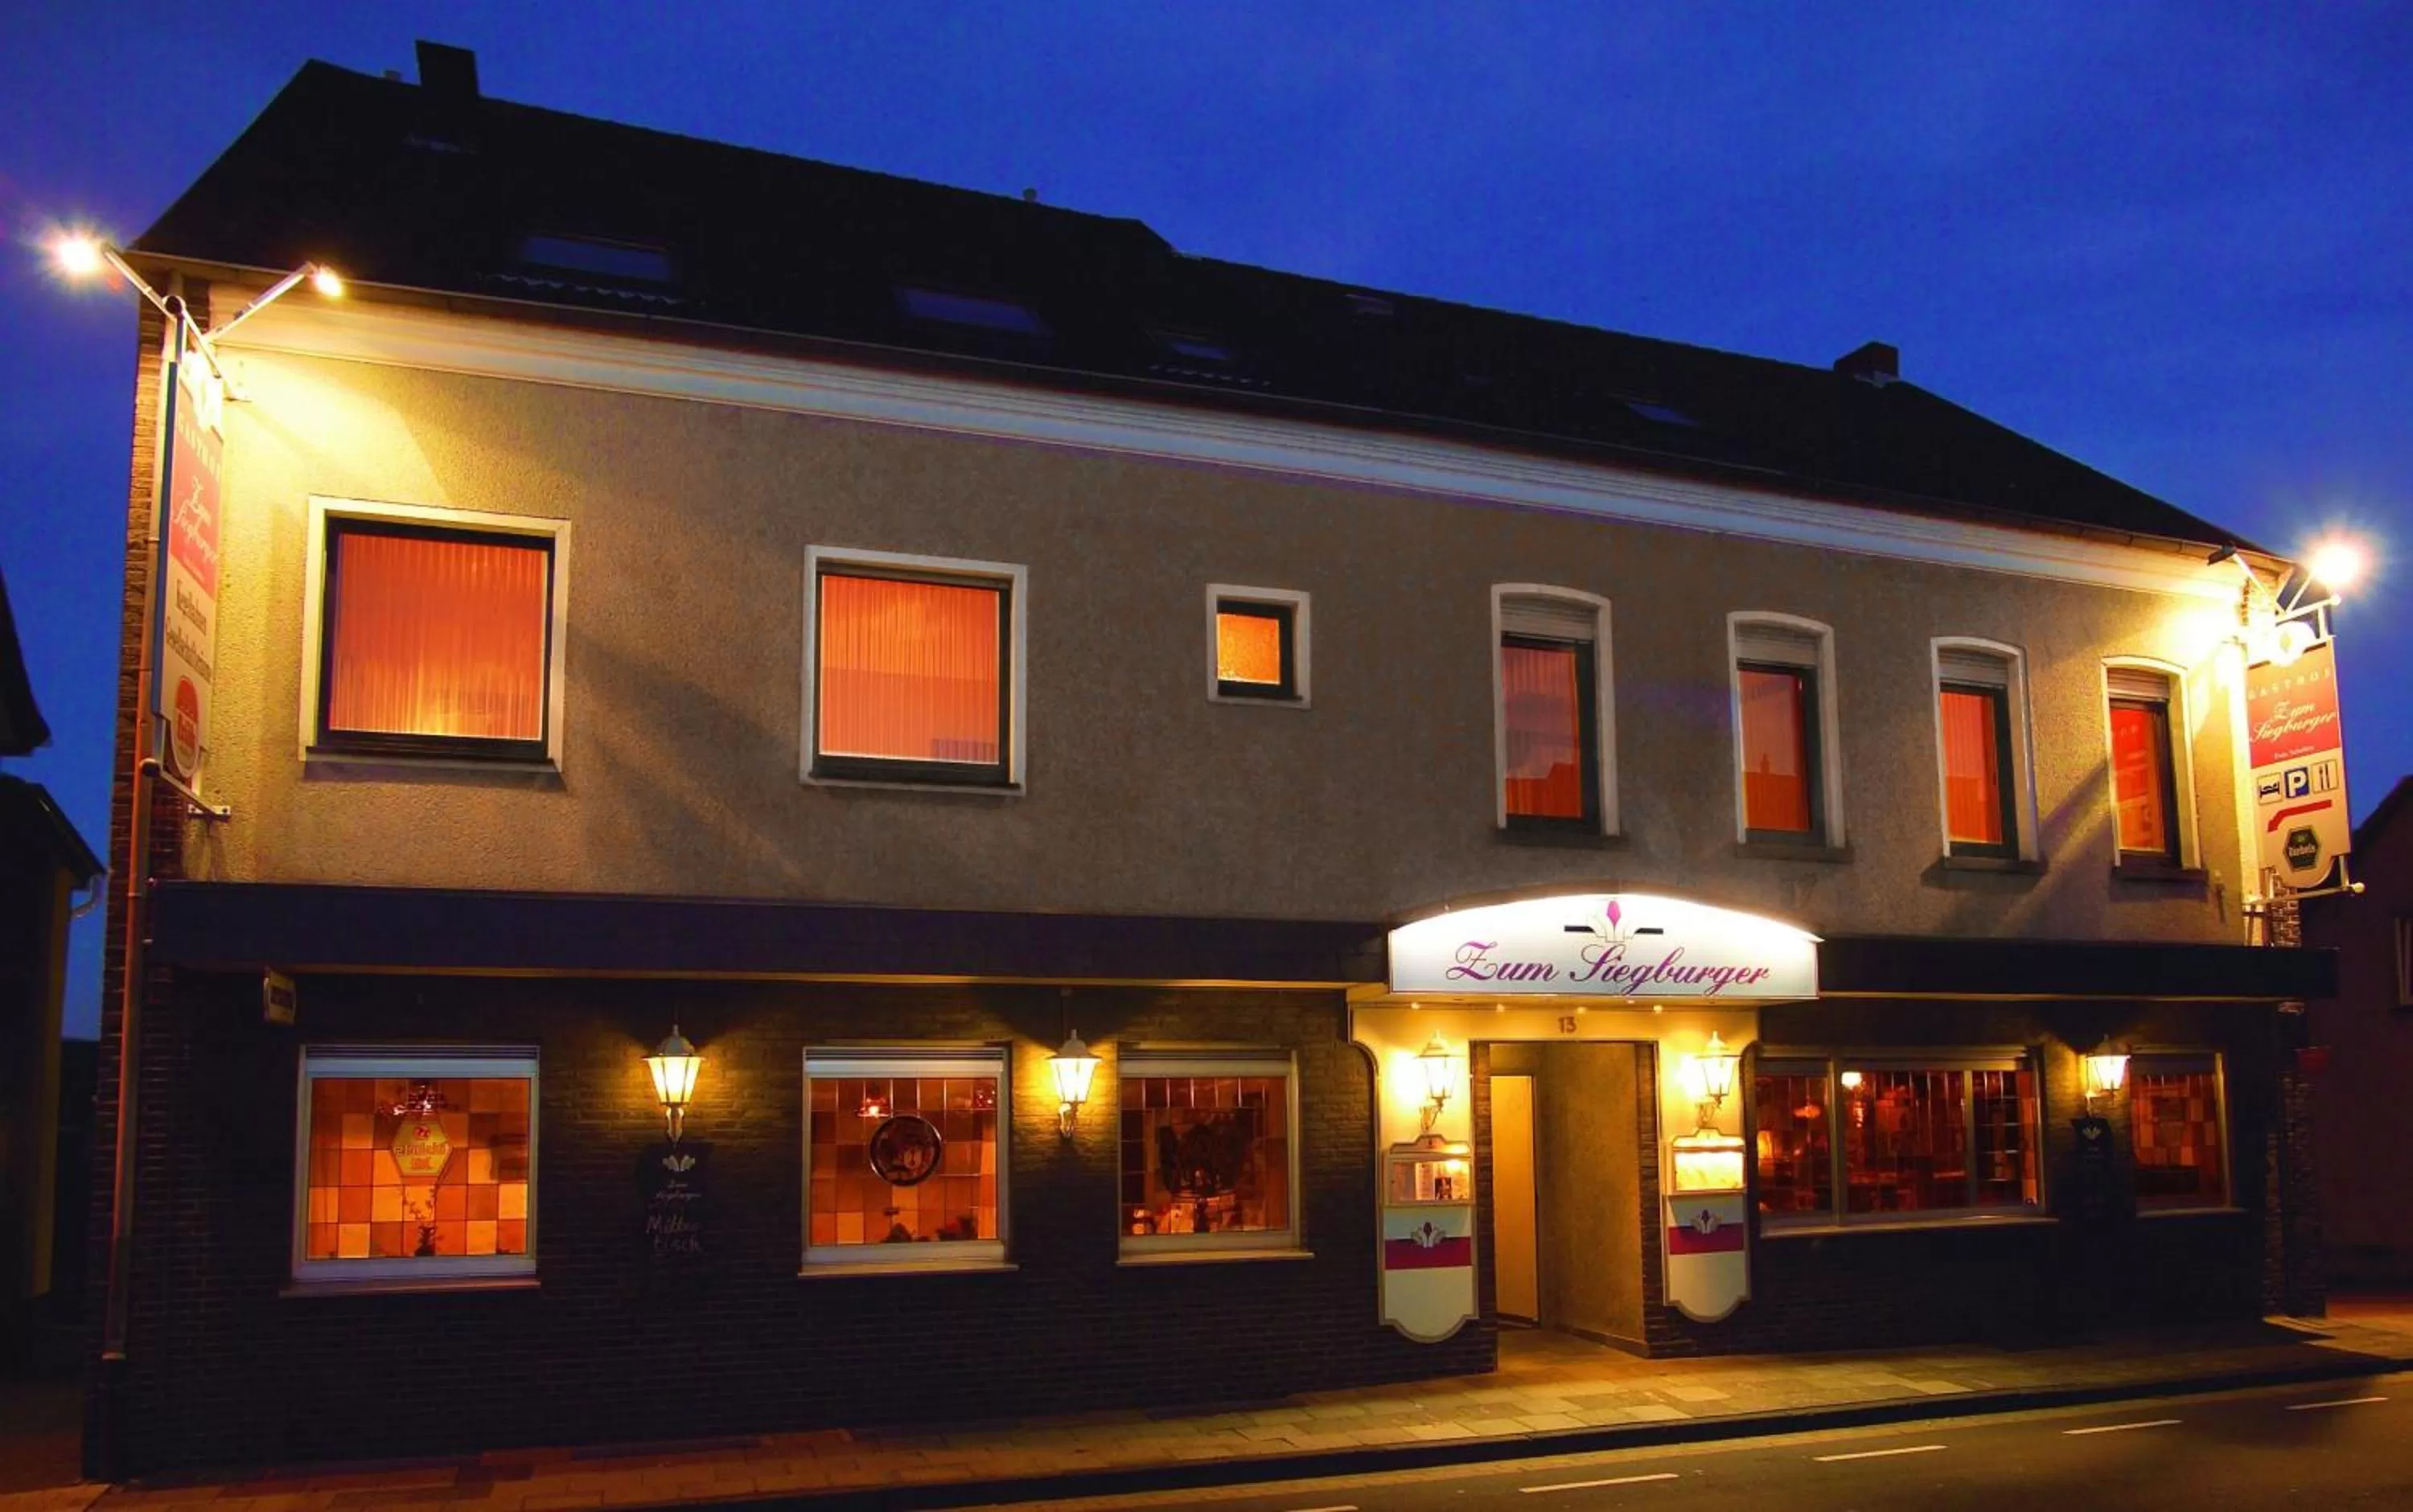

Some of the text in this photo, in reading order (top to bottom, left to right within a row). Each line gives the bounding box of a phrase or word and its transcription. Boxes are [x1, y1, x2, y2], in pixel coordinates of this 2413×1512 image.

[2273, 701, 2316, 721] Zum
[2249, 711, 2336, 744] Siegburger
[2288, 770, 2307, 798] P
[1445, 940, 1770, 995] Zum Siegburger
[1558, 1016, 1577, 1033] 13
